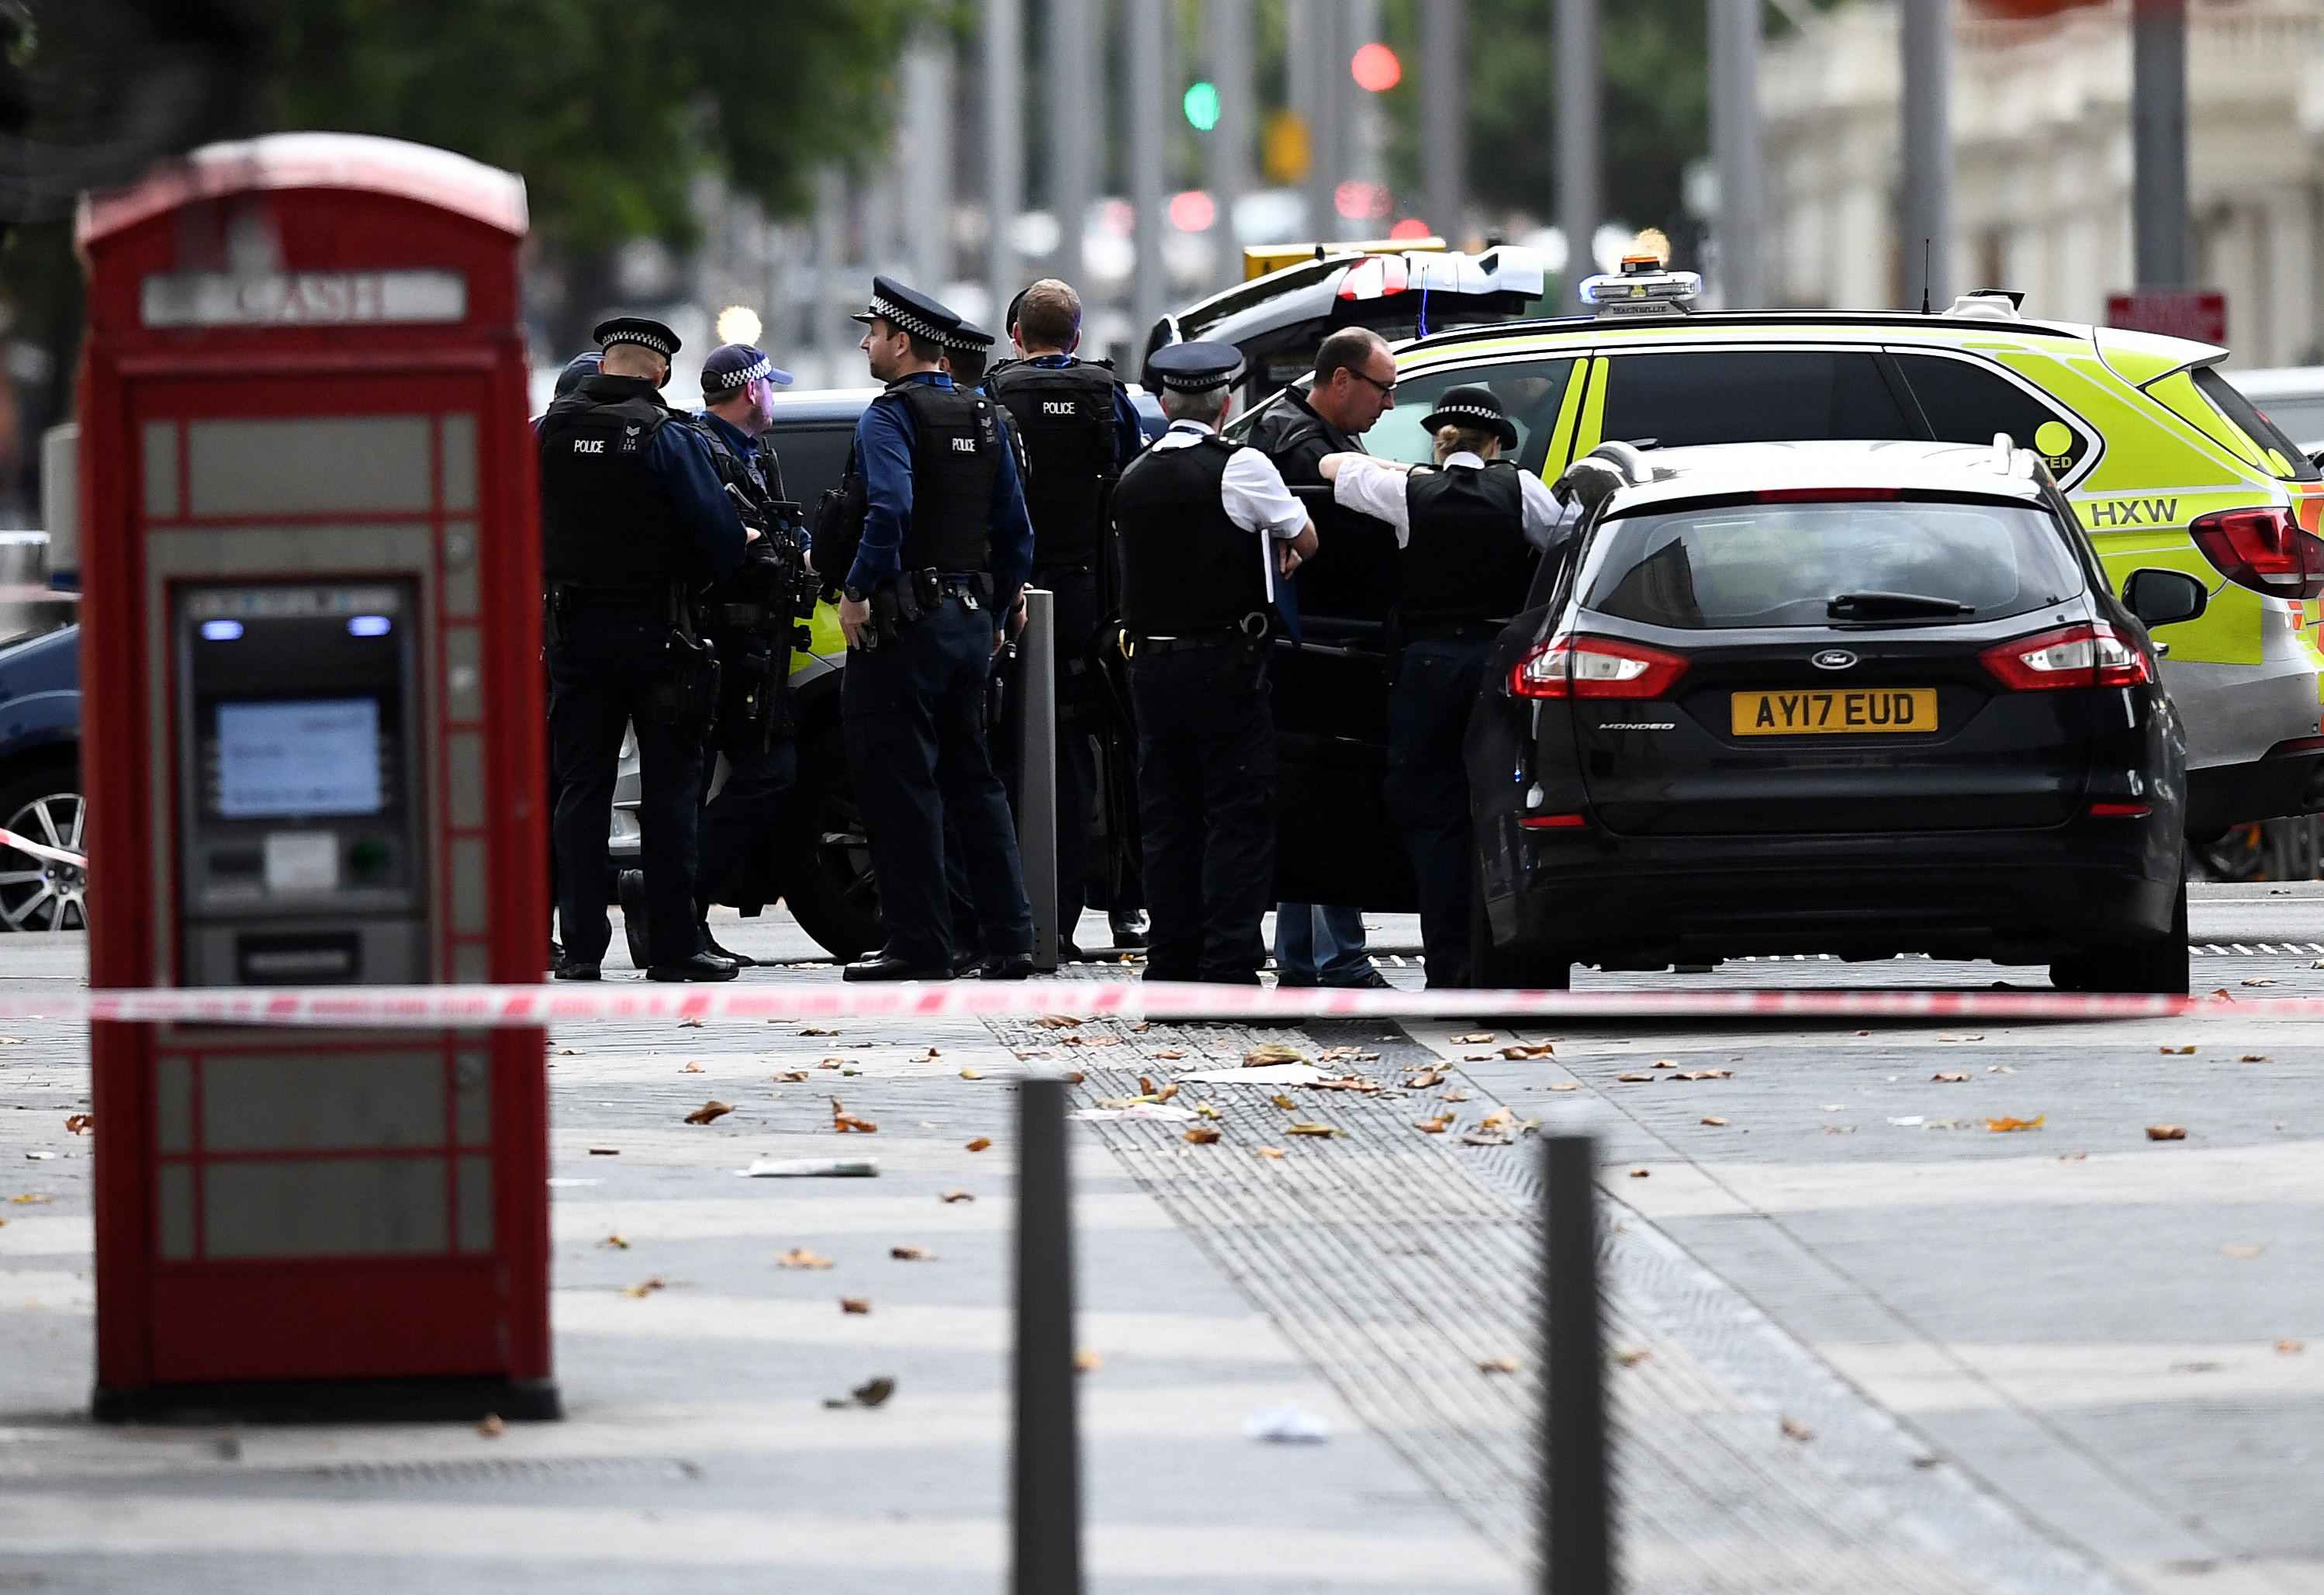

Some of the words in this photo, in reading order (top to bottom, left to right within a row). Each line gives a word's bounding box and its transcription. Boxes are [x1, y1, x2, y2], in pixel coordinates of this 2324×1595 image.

[1043, 402, 1075, 414] POLICE
[574, 439, 605, 453] POLICE
[952, 438, 976, 452] POLICE
[2091, 498, 2178, 527] HXW
[1755, 694, 1833, 728] AY17
[1845, 694, 1914, 725] EUD
